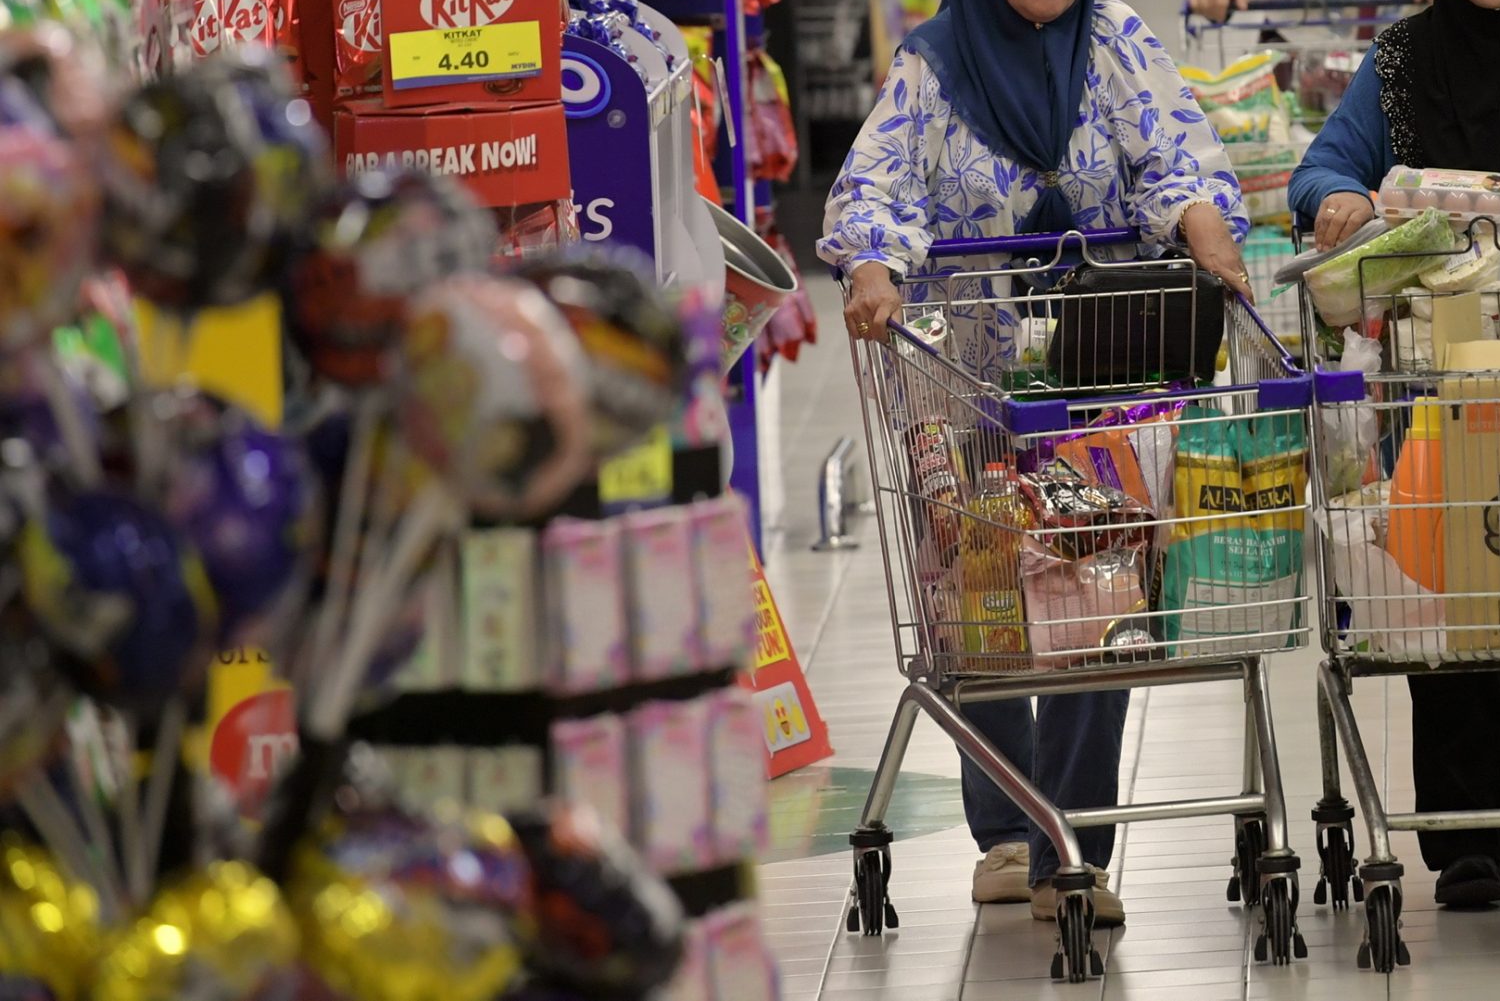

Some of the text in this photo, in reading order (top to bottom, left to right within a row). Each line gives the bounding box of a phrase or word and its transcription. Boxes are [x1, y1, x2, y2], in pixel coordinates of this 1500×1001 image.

[443, 29, 482, 40] KITKAT
[438, 50, 490, 71] 4.40
[481, 134, 537, 170] NOW!
